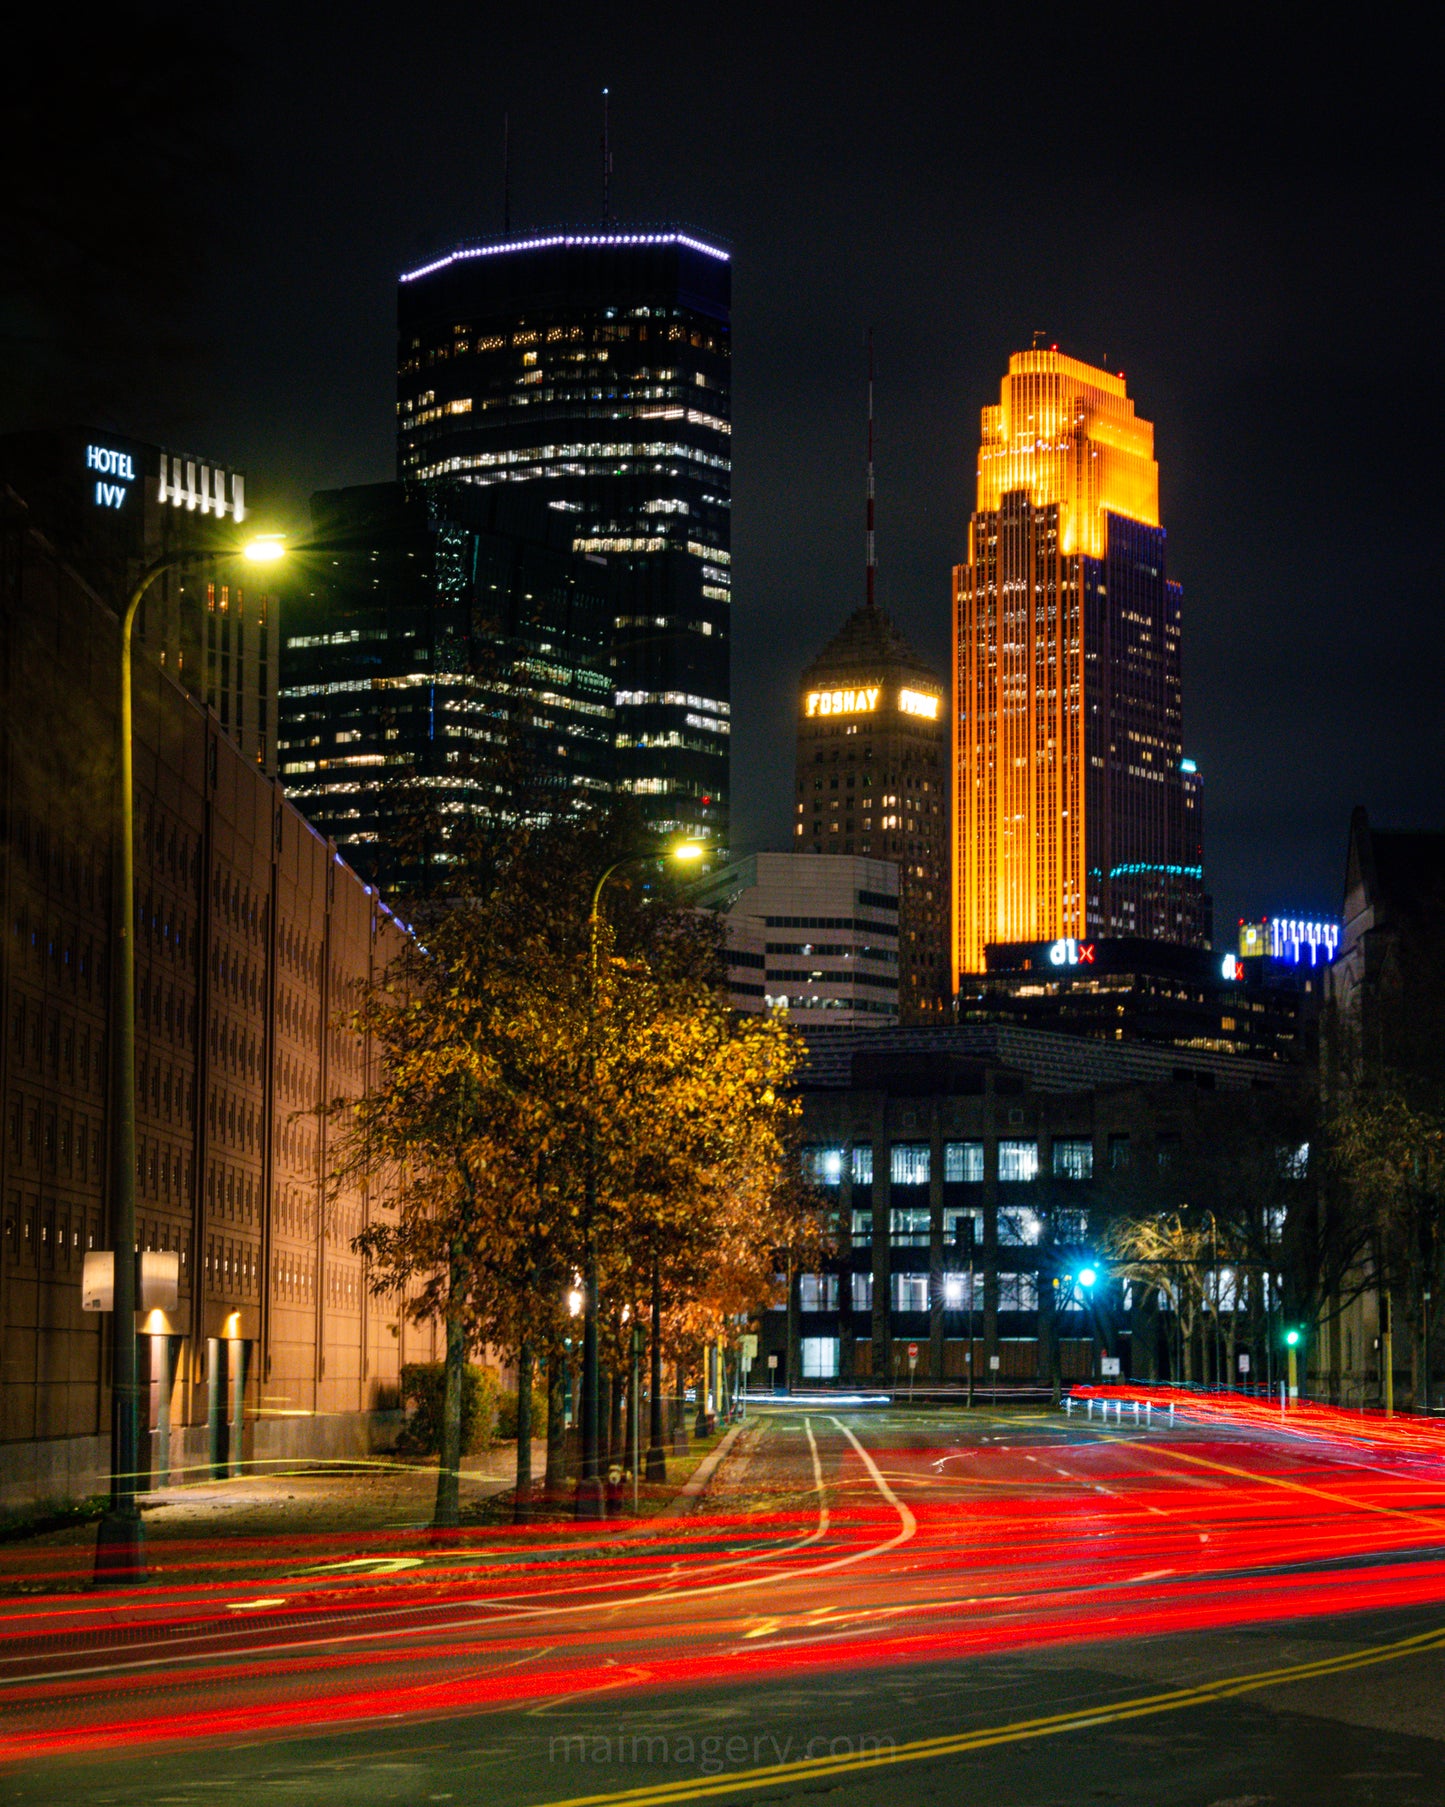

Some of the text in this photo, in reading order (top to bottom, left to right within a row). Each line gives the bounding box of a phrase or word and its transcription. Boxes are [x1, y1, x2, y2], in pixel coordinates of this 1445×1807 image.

[87, 445, 135, 480] HOTEL
[96, 482, 126, 509] IVY
[807, 688, 879, 716] FOSHAY
